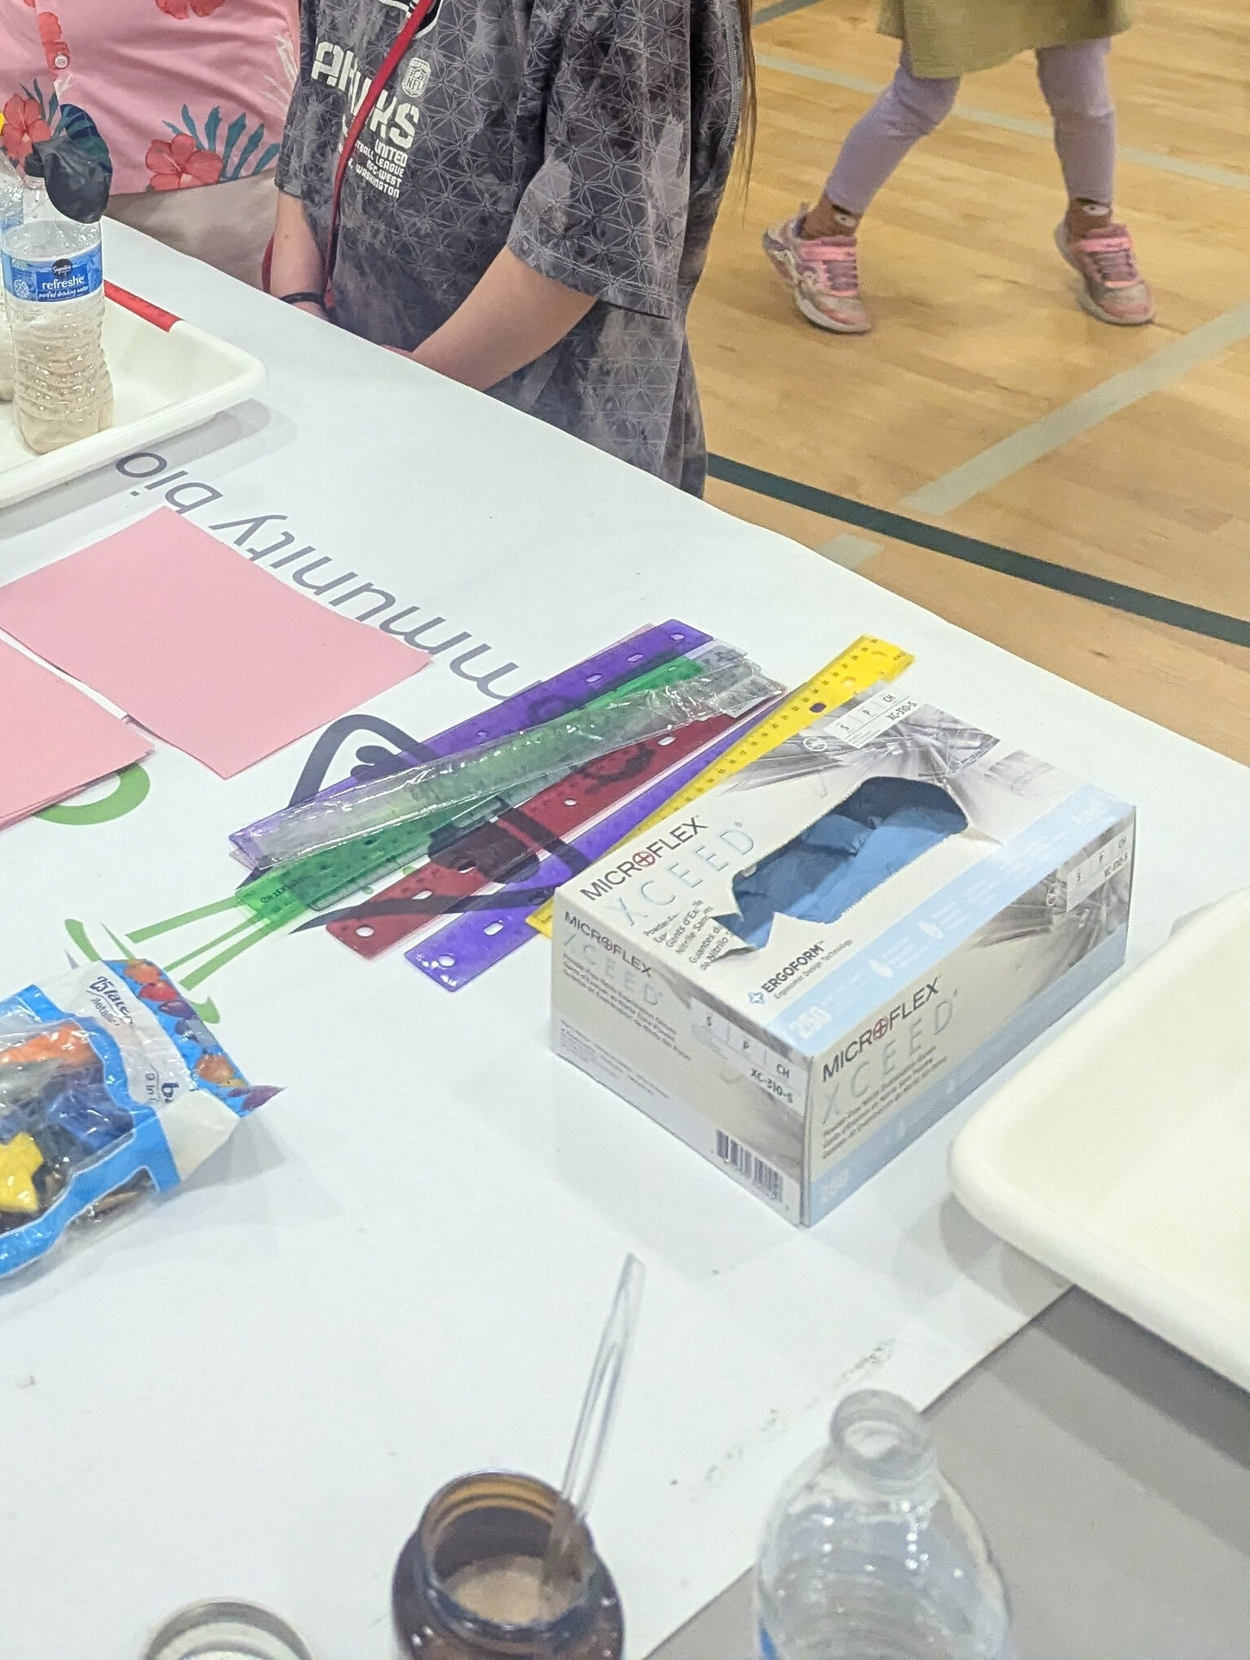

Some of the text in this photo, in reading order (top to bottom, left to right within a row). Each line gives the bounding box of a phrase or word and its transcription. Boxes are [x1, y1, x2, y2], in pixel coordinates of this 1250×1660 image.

[406, 77, 422, 91] NFL
[374, 140, 408, 167] UNITED
[376, 157, 405, 178] LEAGUE
[356, 163, 400, 199] WASHINGTON
[579, 816, 708, 901] MICROFLEX
[565, 911, 652, 978] MICROFLEX
[761, 944, 824, 993] ERGOFORM
[822, 976, 940, 1082] MICROFLEX
